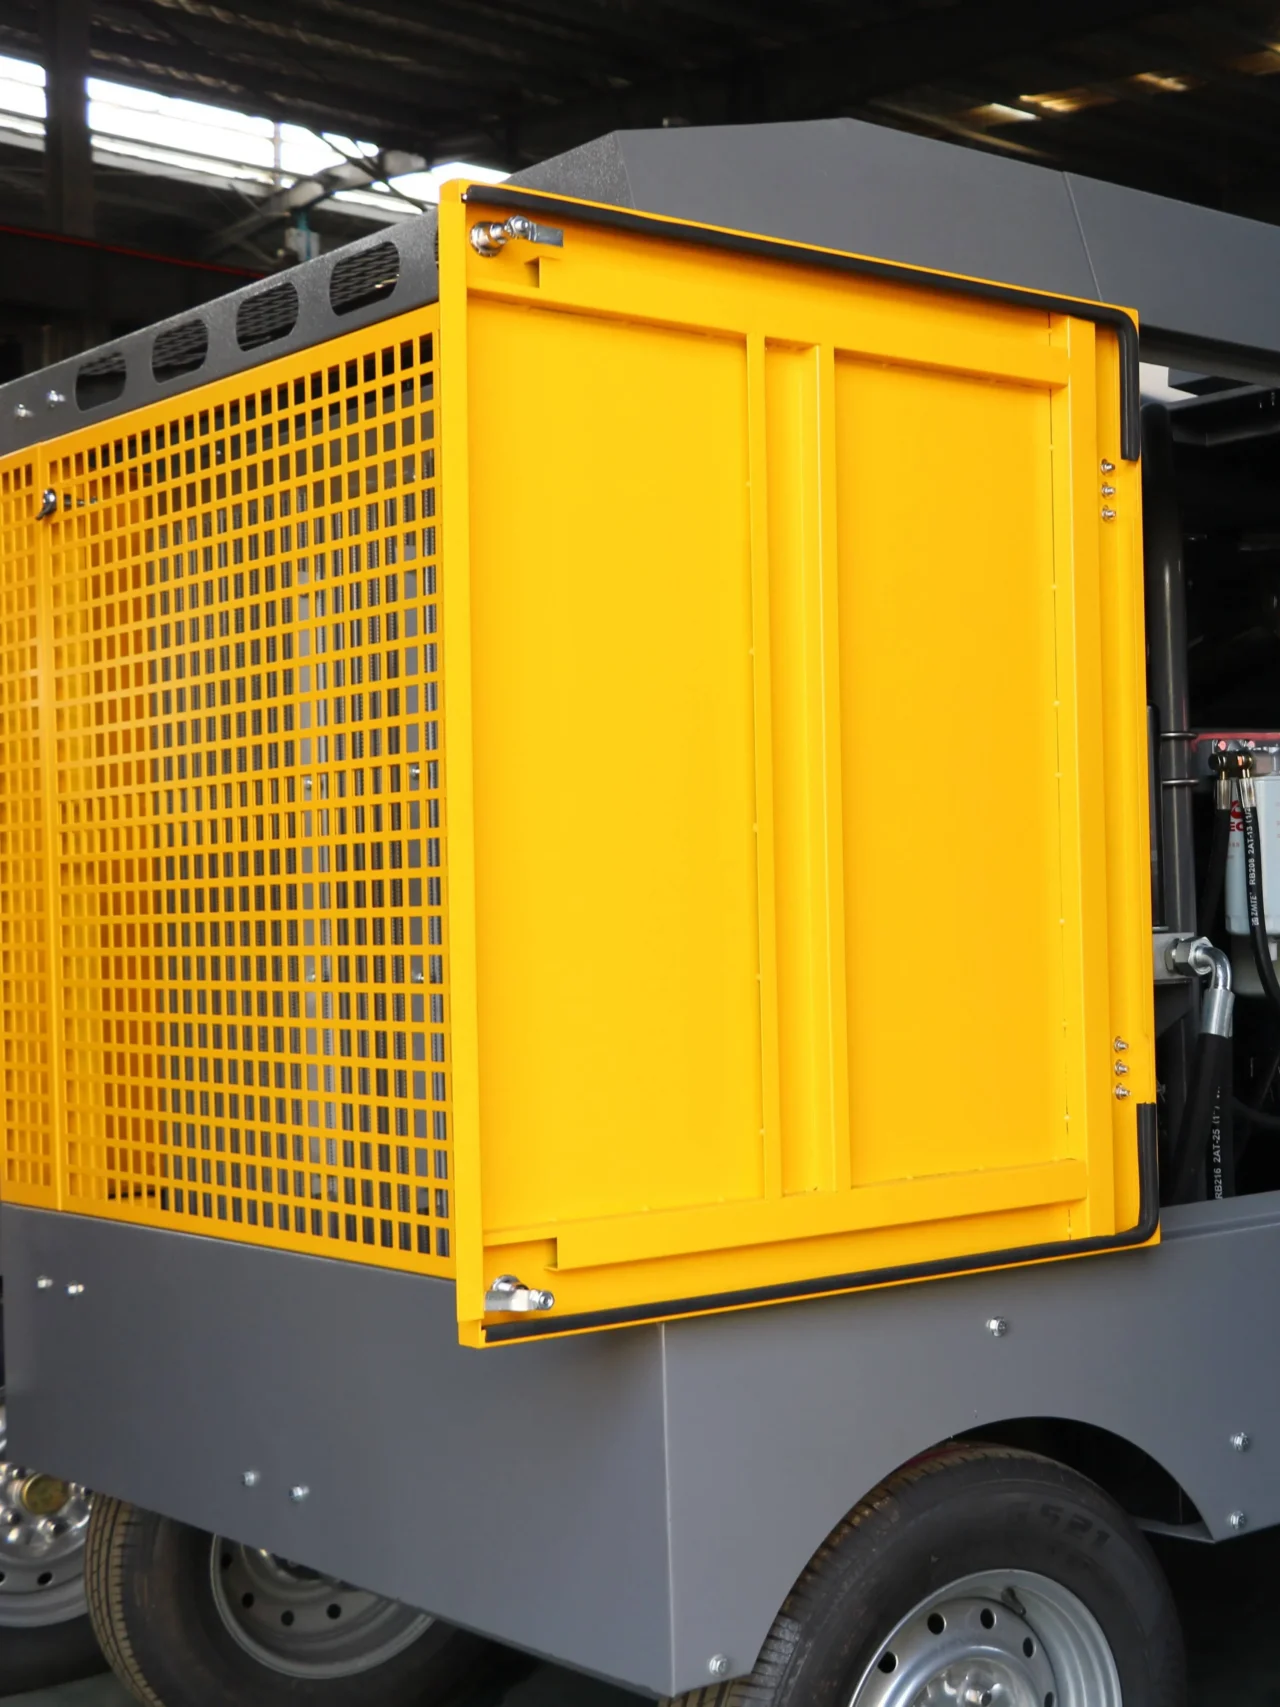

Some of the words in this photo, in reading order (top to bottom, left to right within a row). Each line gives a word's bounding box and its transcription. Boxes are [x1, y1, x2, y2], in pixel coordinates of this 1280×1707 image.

[1246, 826, 1255, 854] 2AT-13
[1248, 859, 1256, 885] RB208
[1212, 1128, 1221, 1163] 2AT-25
[1213, 1168, 1223, 1200] RB216
